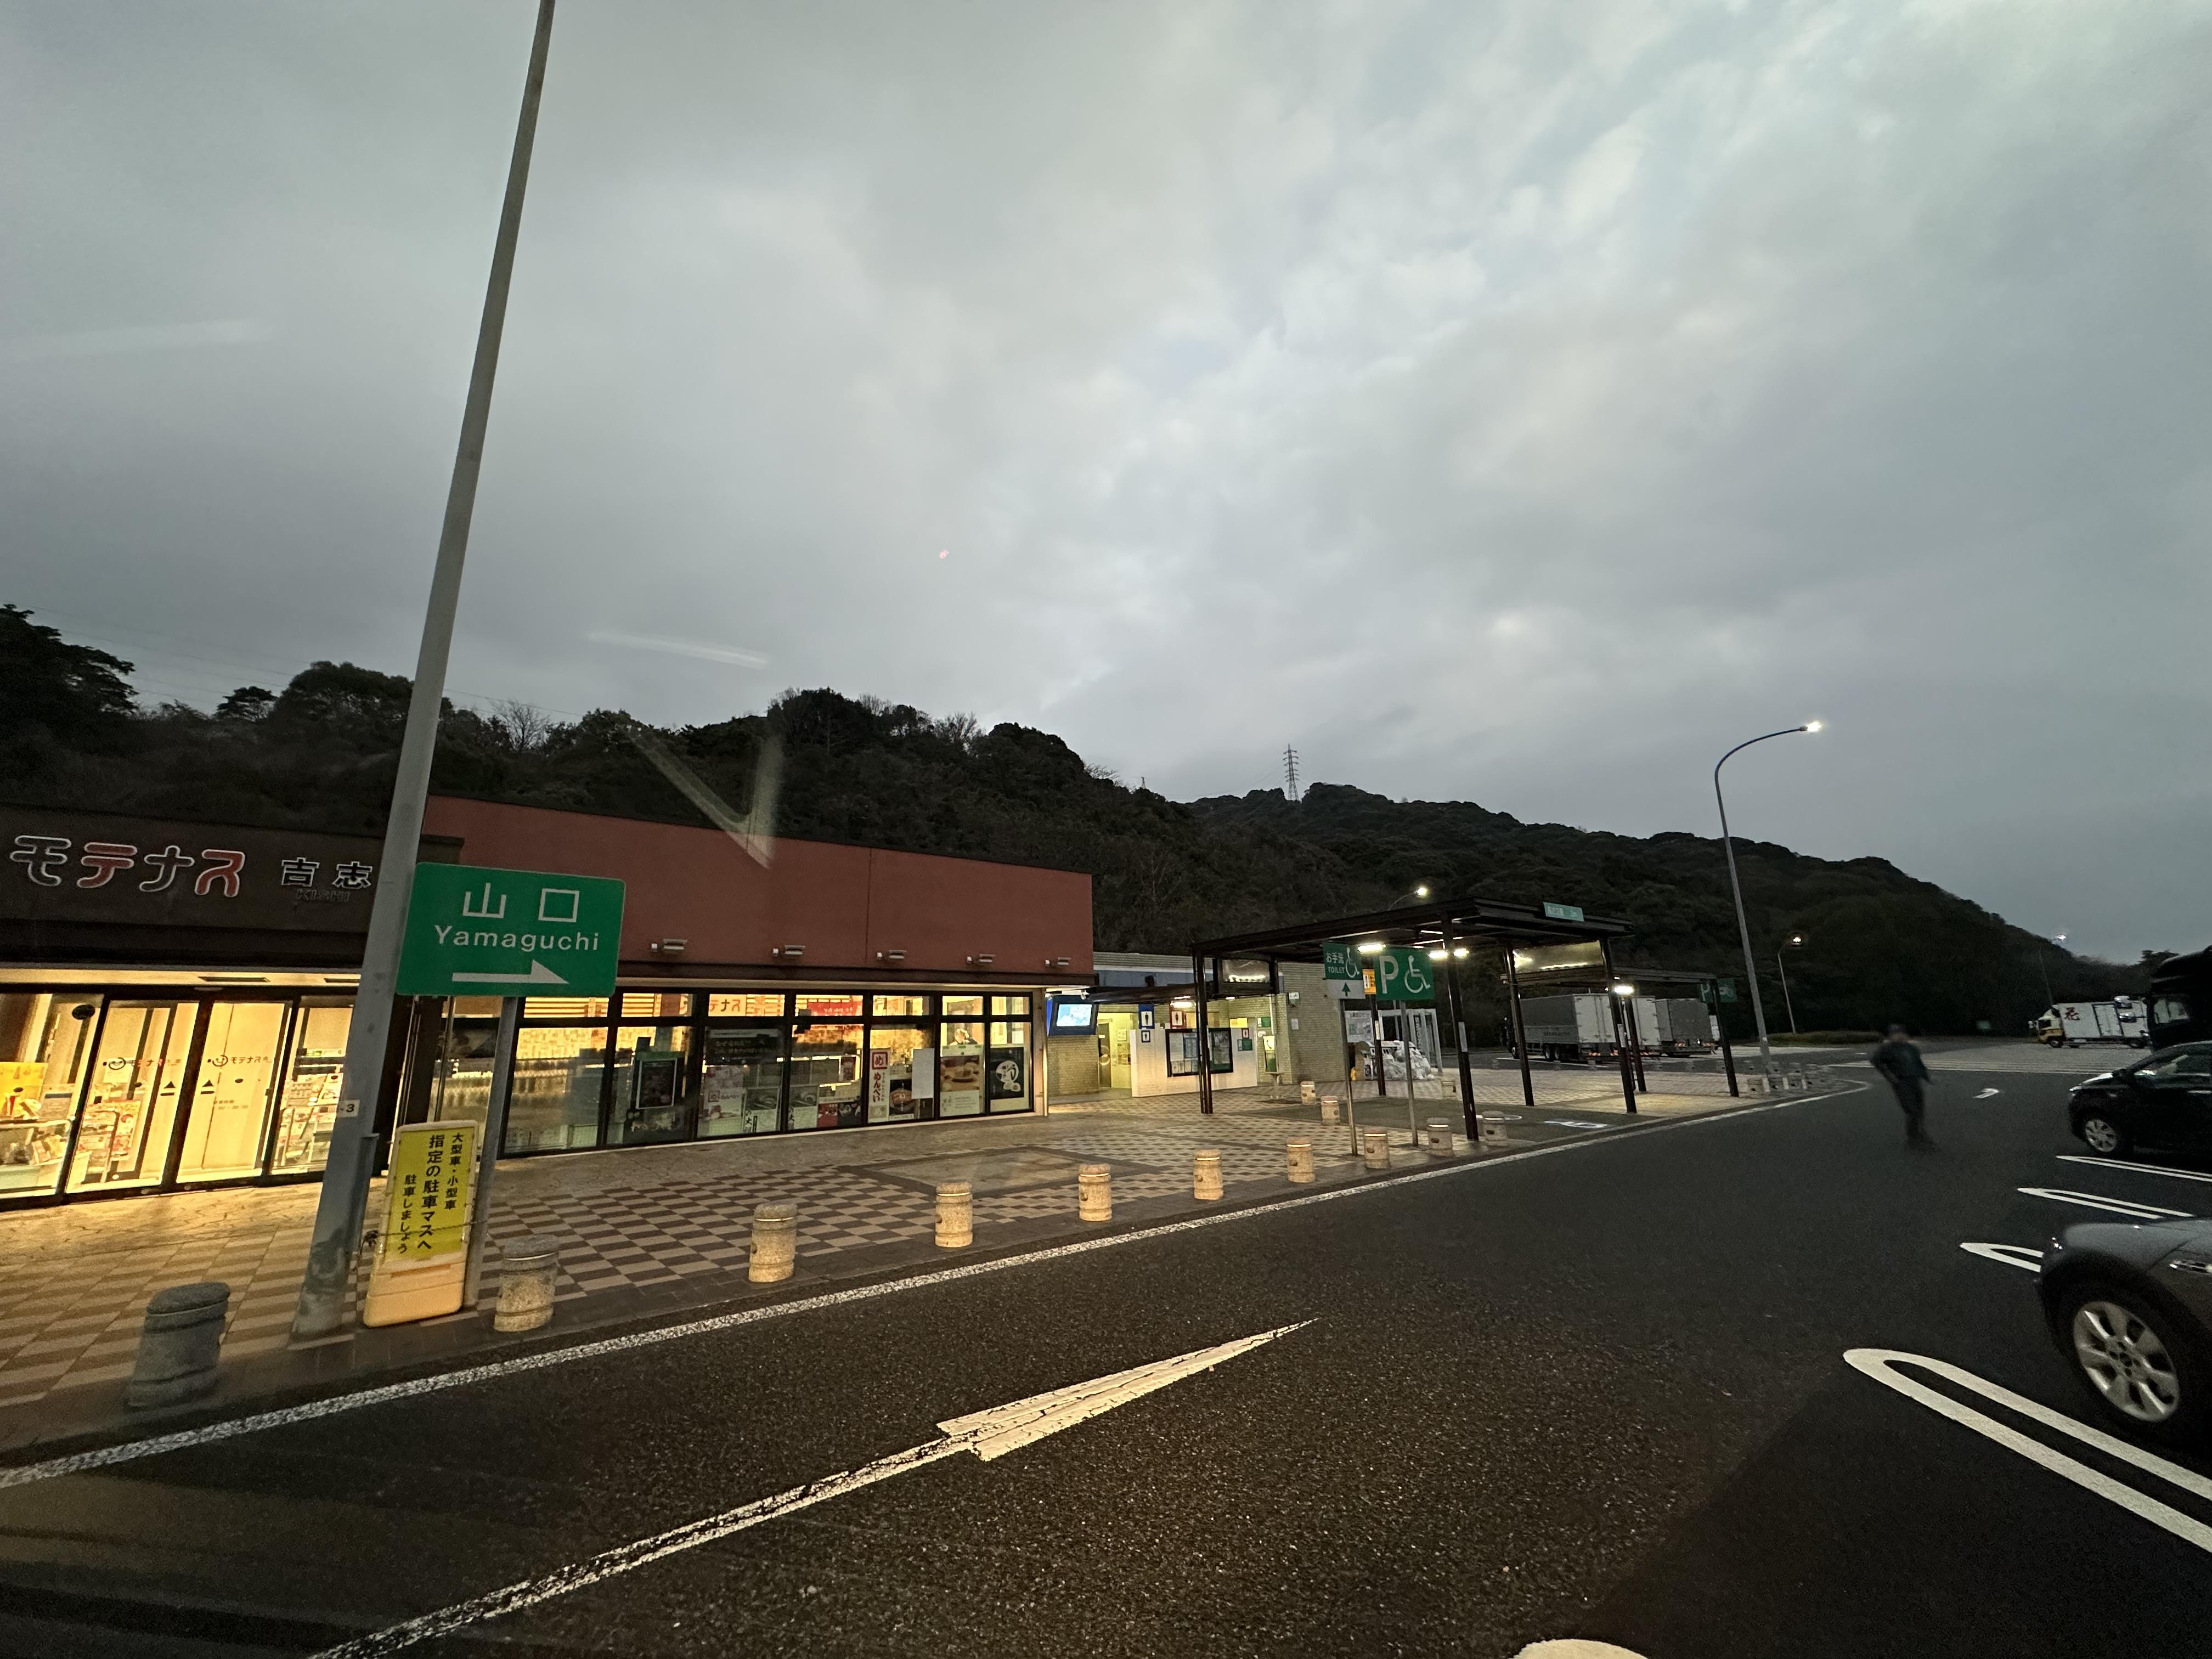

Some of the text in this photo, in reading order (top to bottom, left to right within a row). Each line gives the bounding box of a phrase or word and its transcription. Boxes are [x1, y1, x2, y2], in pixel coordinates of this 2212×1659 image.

[10, 834, 373, 898] モテナス 吉志
[296, 889, 350, 902] KISHI
[462, 882, 580, 923] 山口
[435, 925, 599, 952] Yamaguchi
[1379, 955, 1399, 994] P
[417, 1134, 445, 1250] 指定の駐車マスへ
[443, 1132, 464, 1210] 大型車・小型車
[397, 1173, 417, 1255] 駐車しましょう
